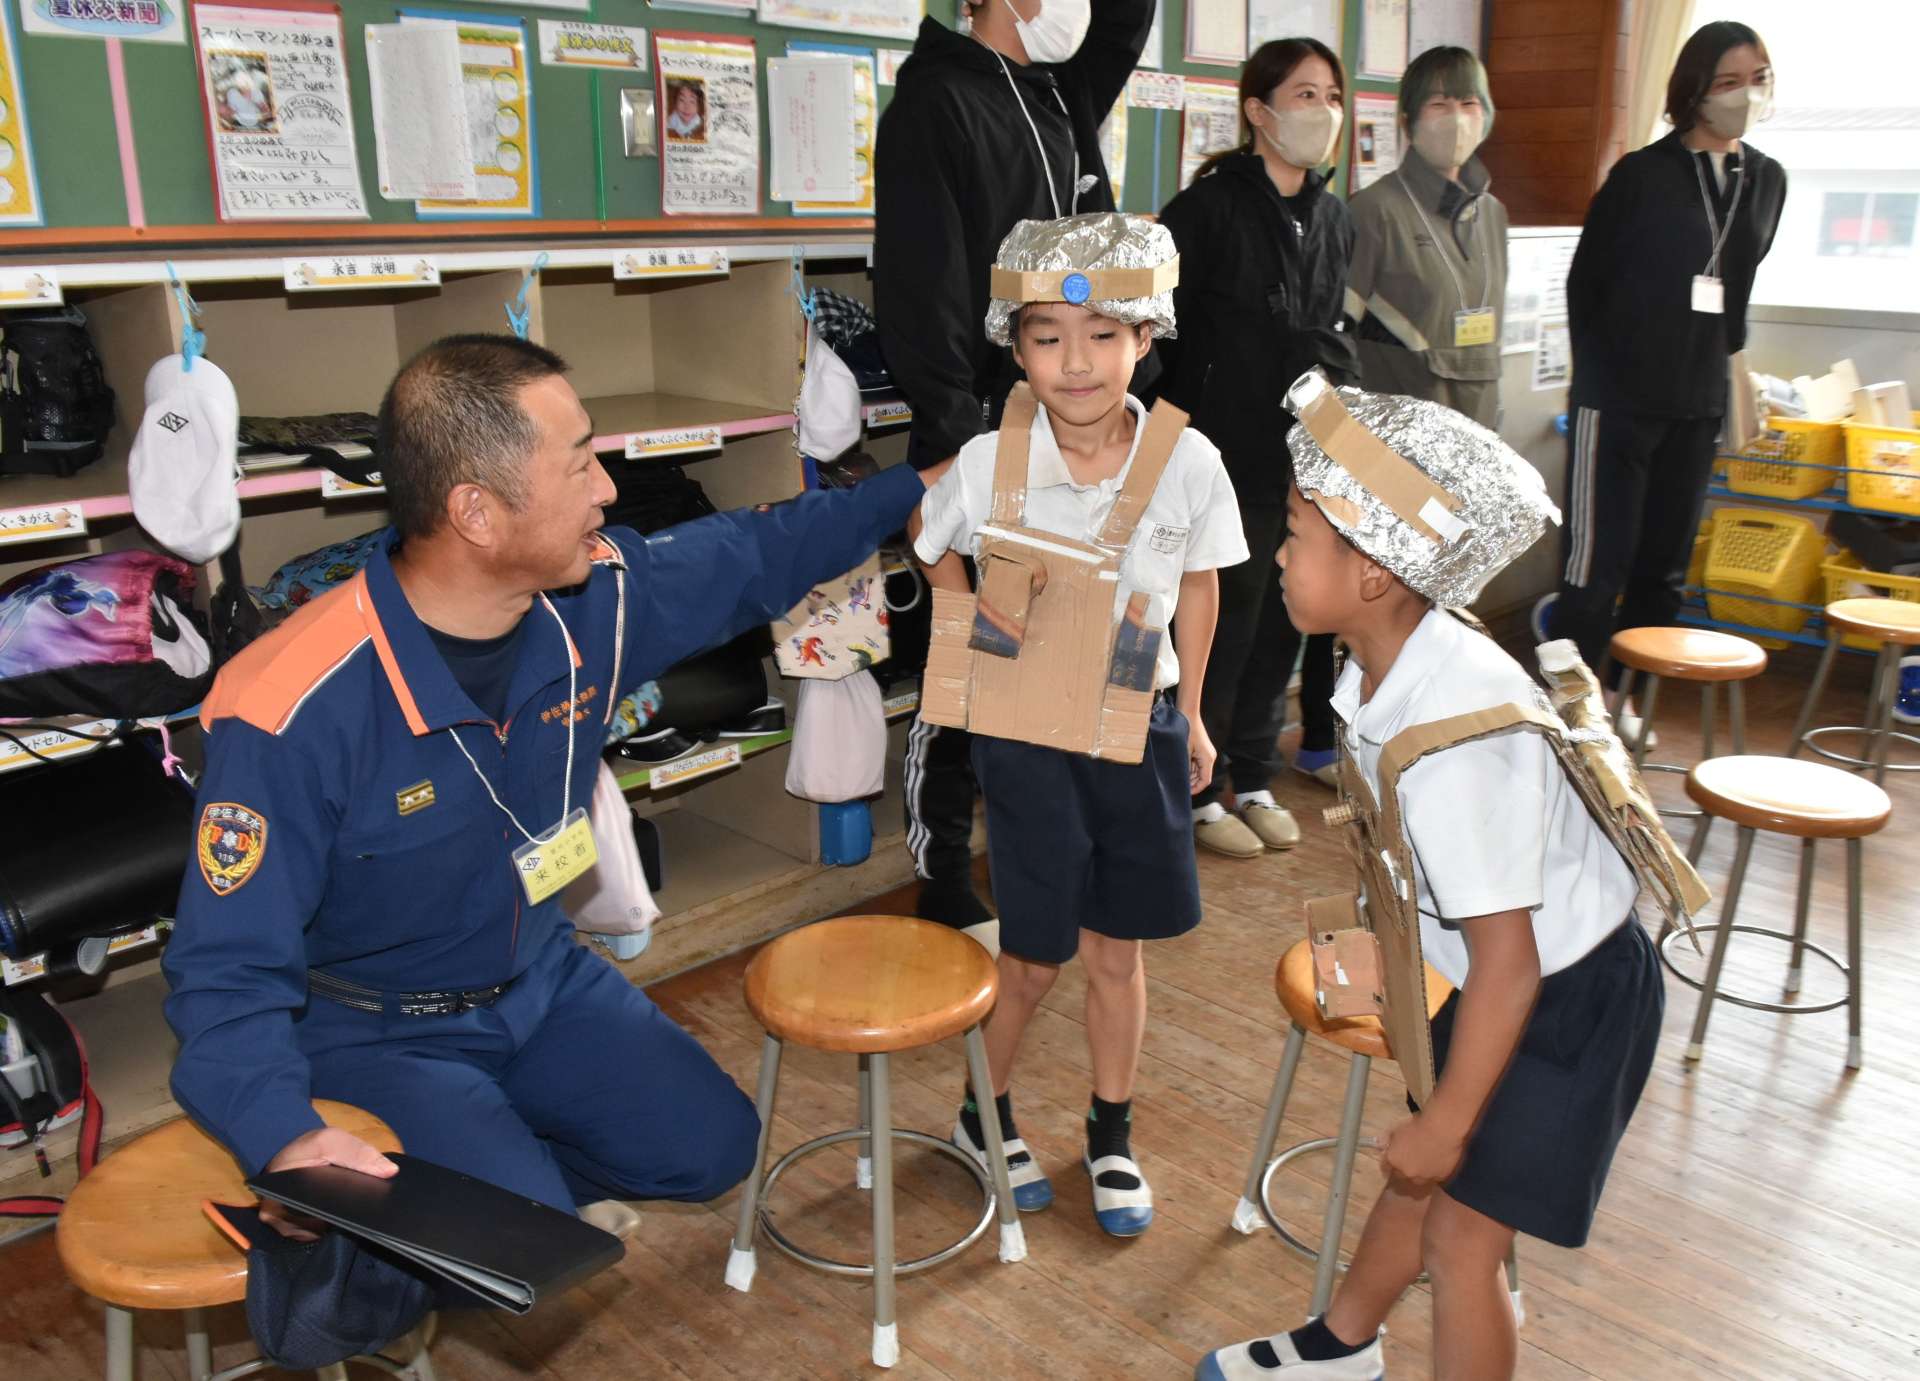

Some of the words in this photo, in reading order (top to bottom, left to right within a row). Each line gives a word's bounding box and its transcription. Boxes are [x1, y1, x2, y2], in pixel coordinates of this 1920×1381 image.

[50, 0, 161, 24] 夏休み新聞
[217, 852, 236, 863] 119
